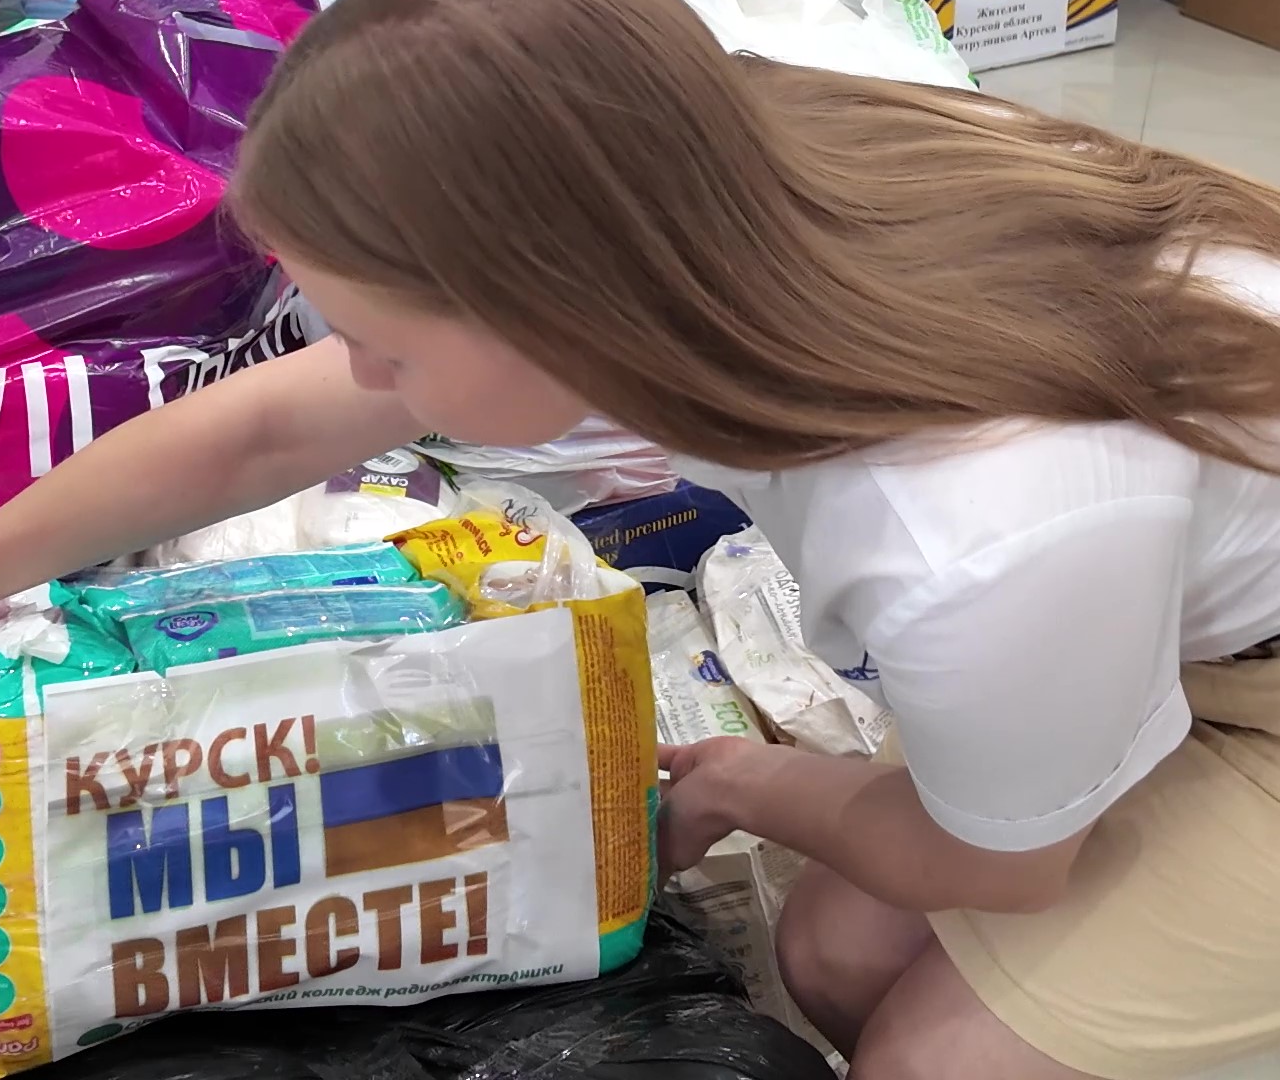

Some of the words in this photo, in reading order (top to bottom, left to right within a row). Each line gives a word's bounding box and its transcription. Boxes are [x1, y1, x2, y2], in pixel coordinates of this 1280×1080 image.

[956, 21, 1001, 38] Курской
[1003, 14, 1043, 29] области
[976, 3, 1026, 19] Жителям
[1019, 24, 1057, 39] Артека
[360, 474, 409, 487] САХАР
[624, 507, 698, 546] premium
[710, 700, 749, 735] ECO
[65, 713, 322, 816] КУРСК!
[105, 783, 302, 921] МЫ
[110, 871, 488, 1019] ВМЕСТЕ!
[301, 981, 383, 999] колледж
[384, 963, 565, 998] радиоэлектроники
